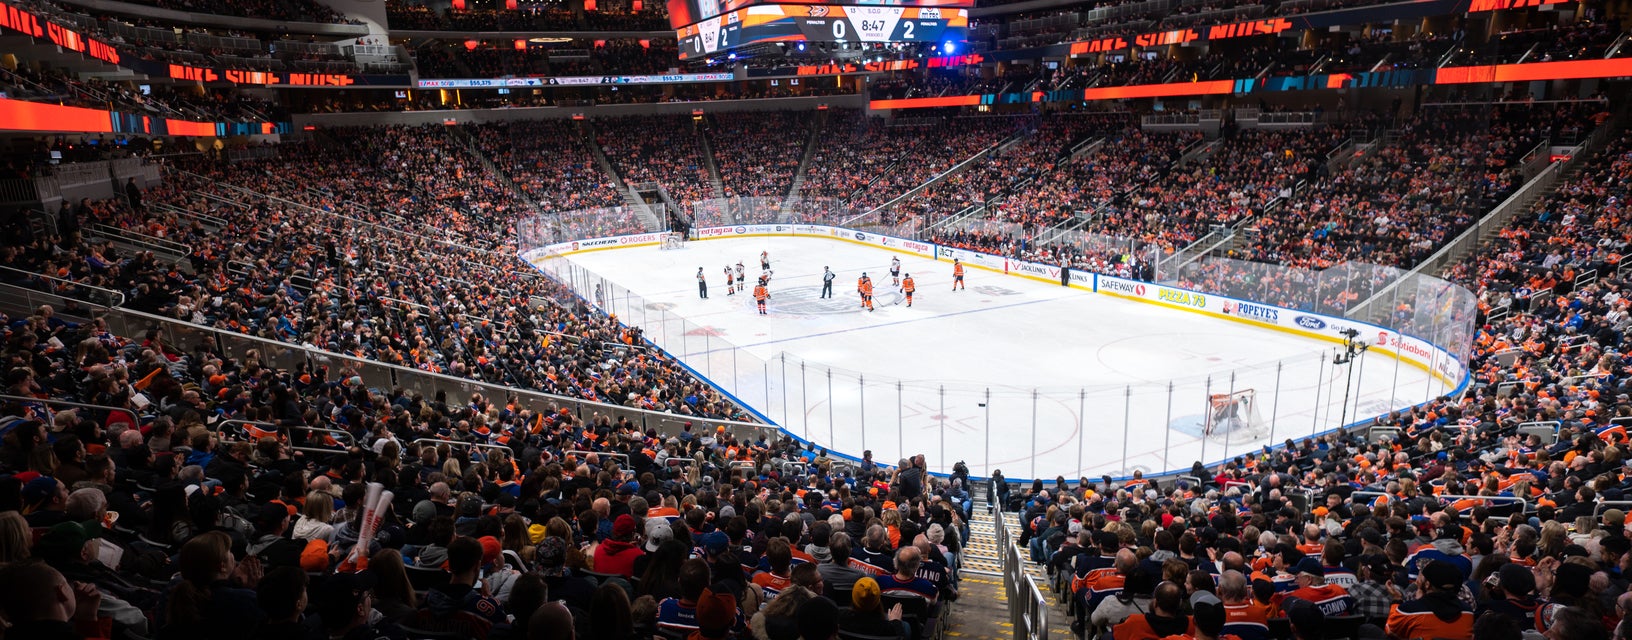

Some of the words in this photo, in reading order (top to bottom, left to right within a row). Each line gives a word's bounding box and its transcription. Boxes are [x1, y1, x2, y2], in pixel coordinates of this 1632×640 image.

[832, 20, 845, 38] 0
[861, 20, 885, 31] 8:47
[903, 21, 915, 39] 2
[694, 36, 700, 53] 0
[721, 28, 728, 46] 2
[1070, 37, 1128, 55] MAKE
[169, 64, 218, 82] MAKE
[225, 69, 280, 85] SOME
[628, 235, 656, 244] ROGERS
[1101, 279, 1136, 294] SAFEWAY
[1158, 287, 1191, 306] PIZZA
[1192, 293, 1207, 308] 73
[1299, 316, 1321, 330] Ford
[1390, 338, 1431, 361] Scotiaban
[914, 569, 940, 582] LIANO
